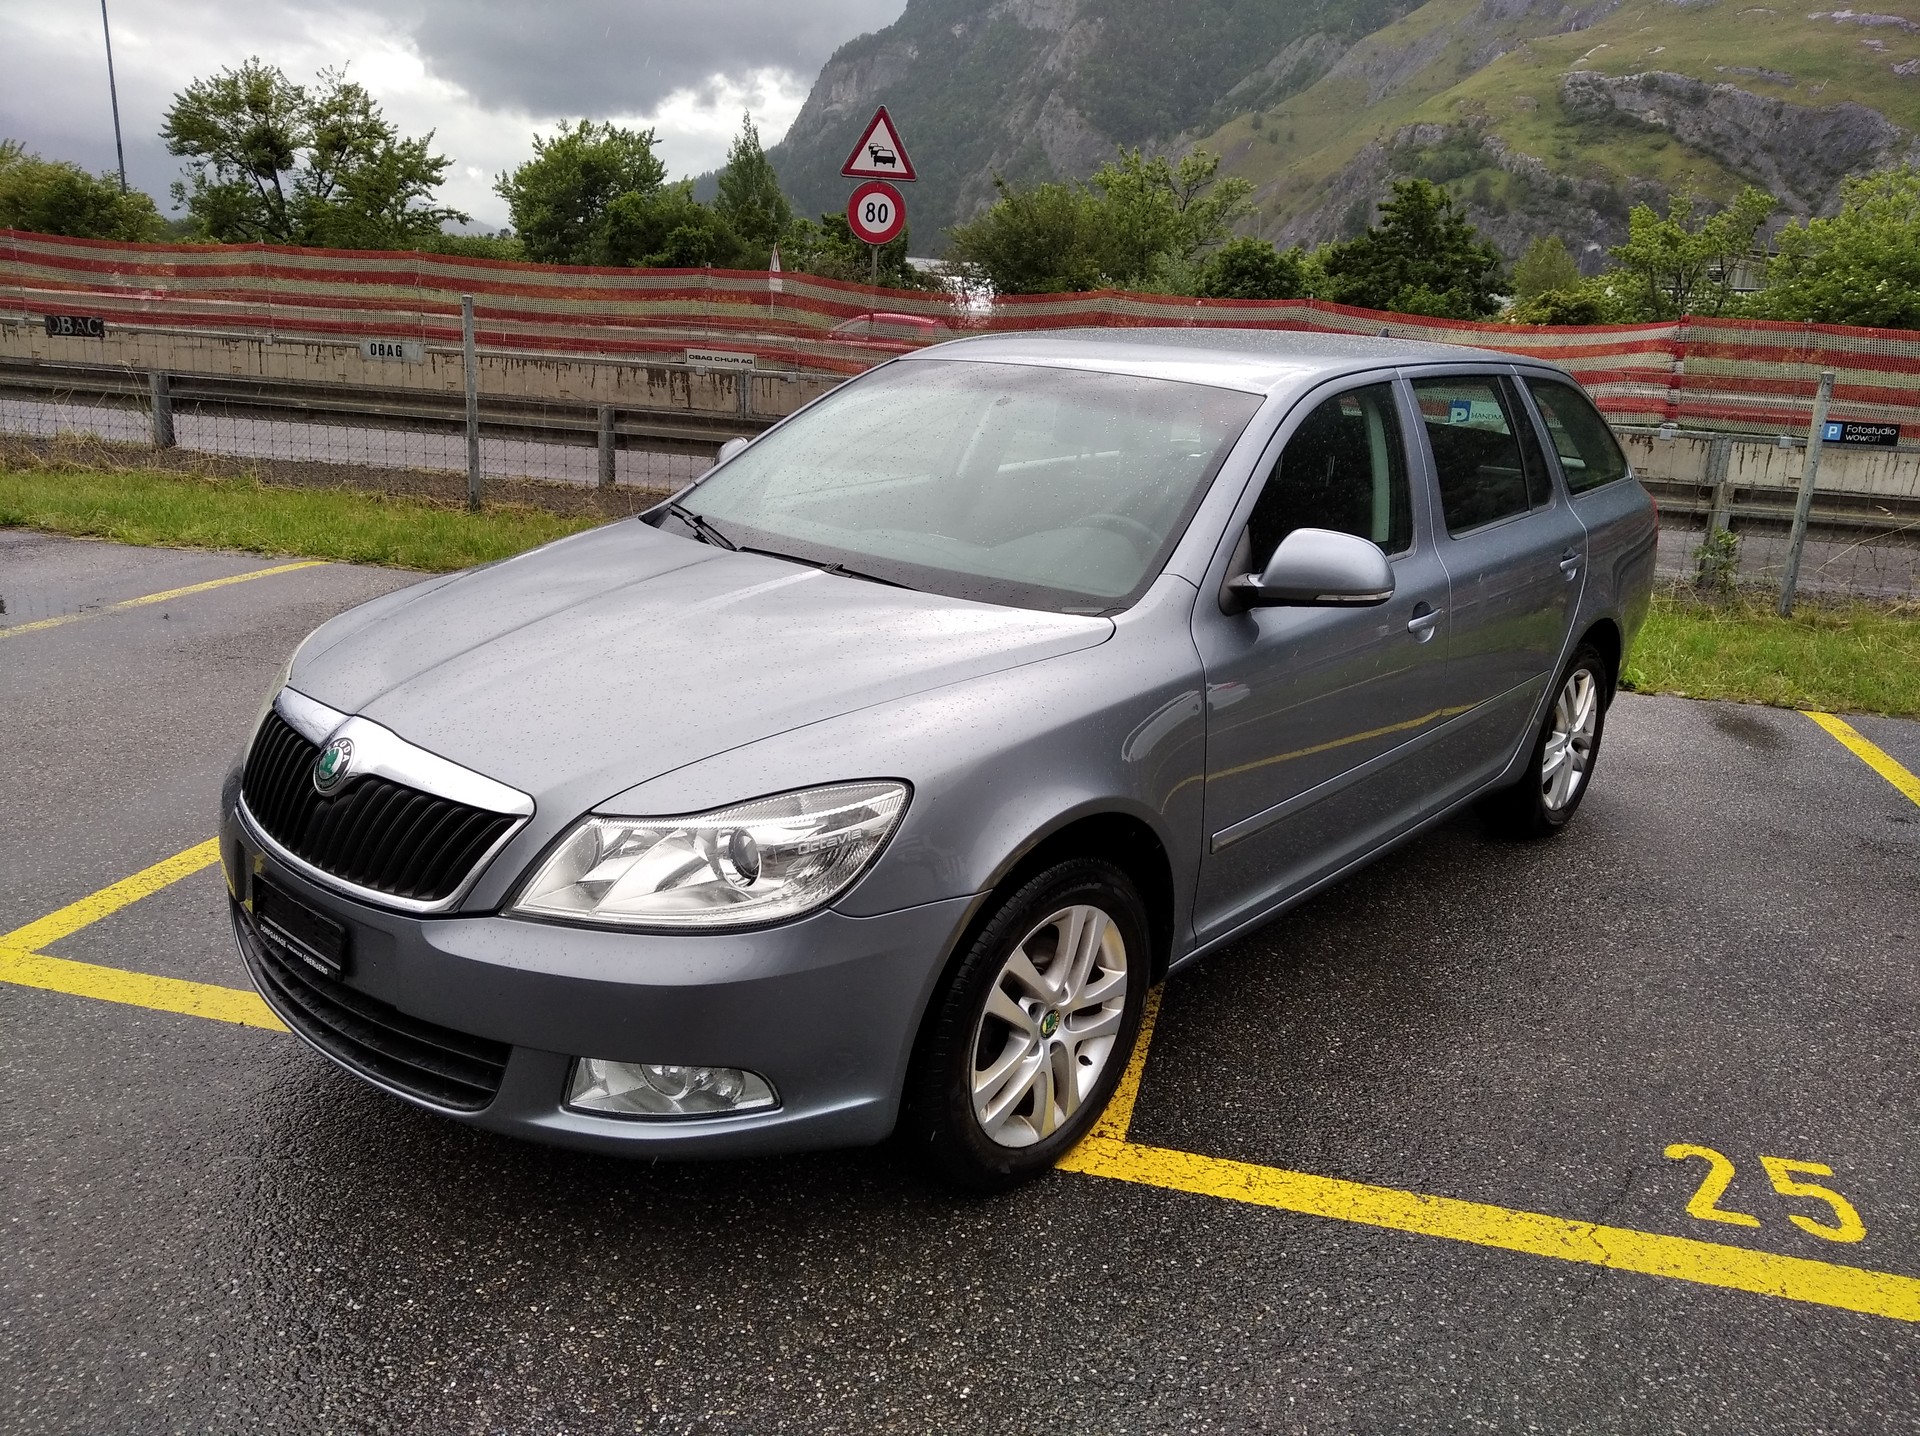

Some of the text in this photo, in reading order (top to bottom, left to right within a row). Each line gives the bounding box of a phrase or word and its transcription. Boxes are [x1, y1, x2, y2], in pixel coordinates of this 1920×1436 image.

[865, 202, 888, 223] 80
[370, 343, 402, 357] OBAG
[1828, 426, 1838, 438] P
[1846, 425, 1897, 435] Fotostudio
[1845, 434, 1880, 442] wowart
[1664, 1143, 1867, 1243] 25
